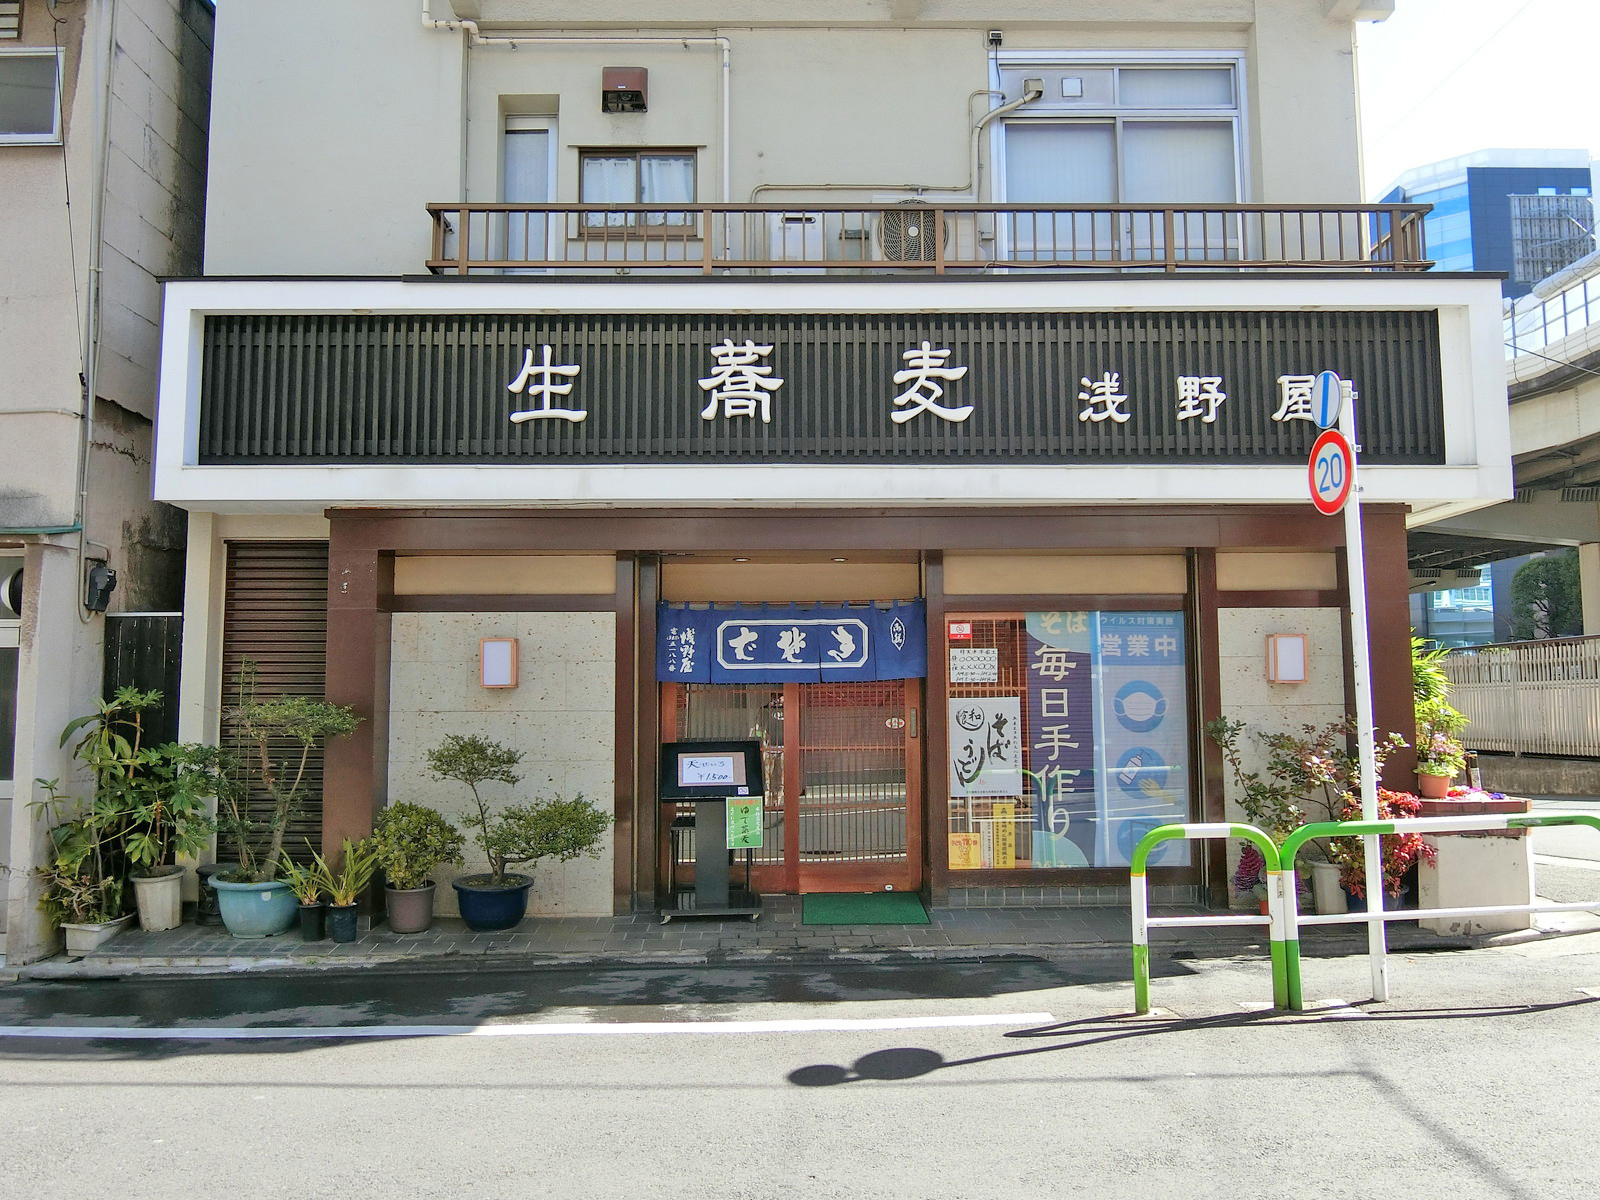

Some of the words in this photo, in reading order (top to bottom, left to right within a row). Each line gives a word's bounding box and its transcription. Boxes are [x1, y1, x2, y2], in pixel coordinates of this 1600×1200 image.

[1079, 371, 1313, 424] 浅野屋
[1317, 452, 1343, 491] 20
[1040, 611, 1088, 635] そば
[1101, 633, 1177, 657] 営業中
[953, 738, 985, 788] うどん
[986, 712, 1011, 765] そば
[1031, 645, 1081, 840] 毎日手作り
